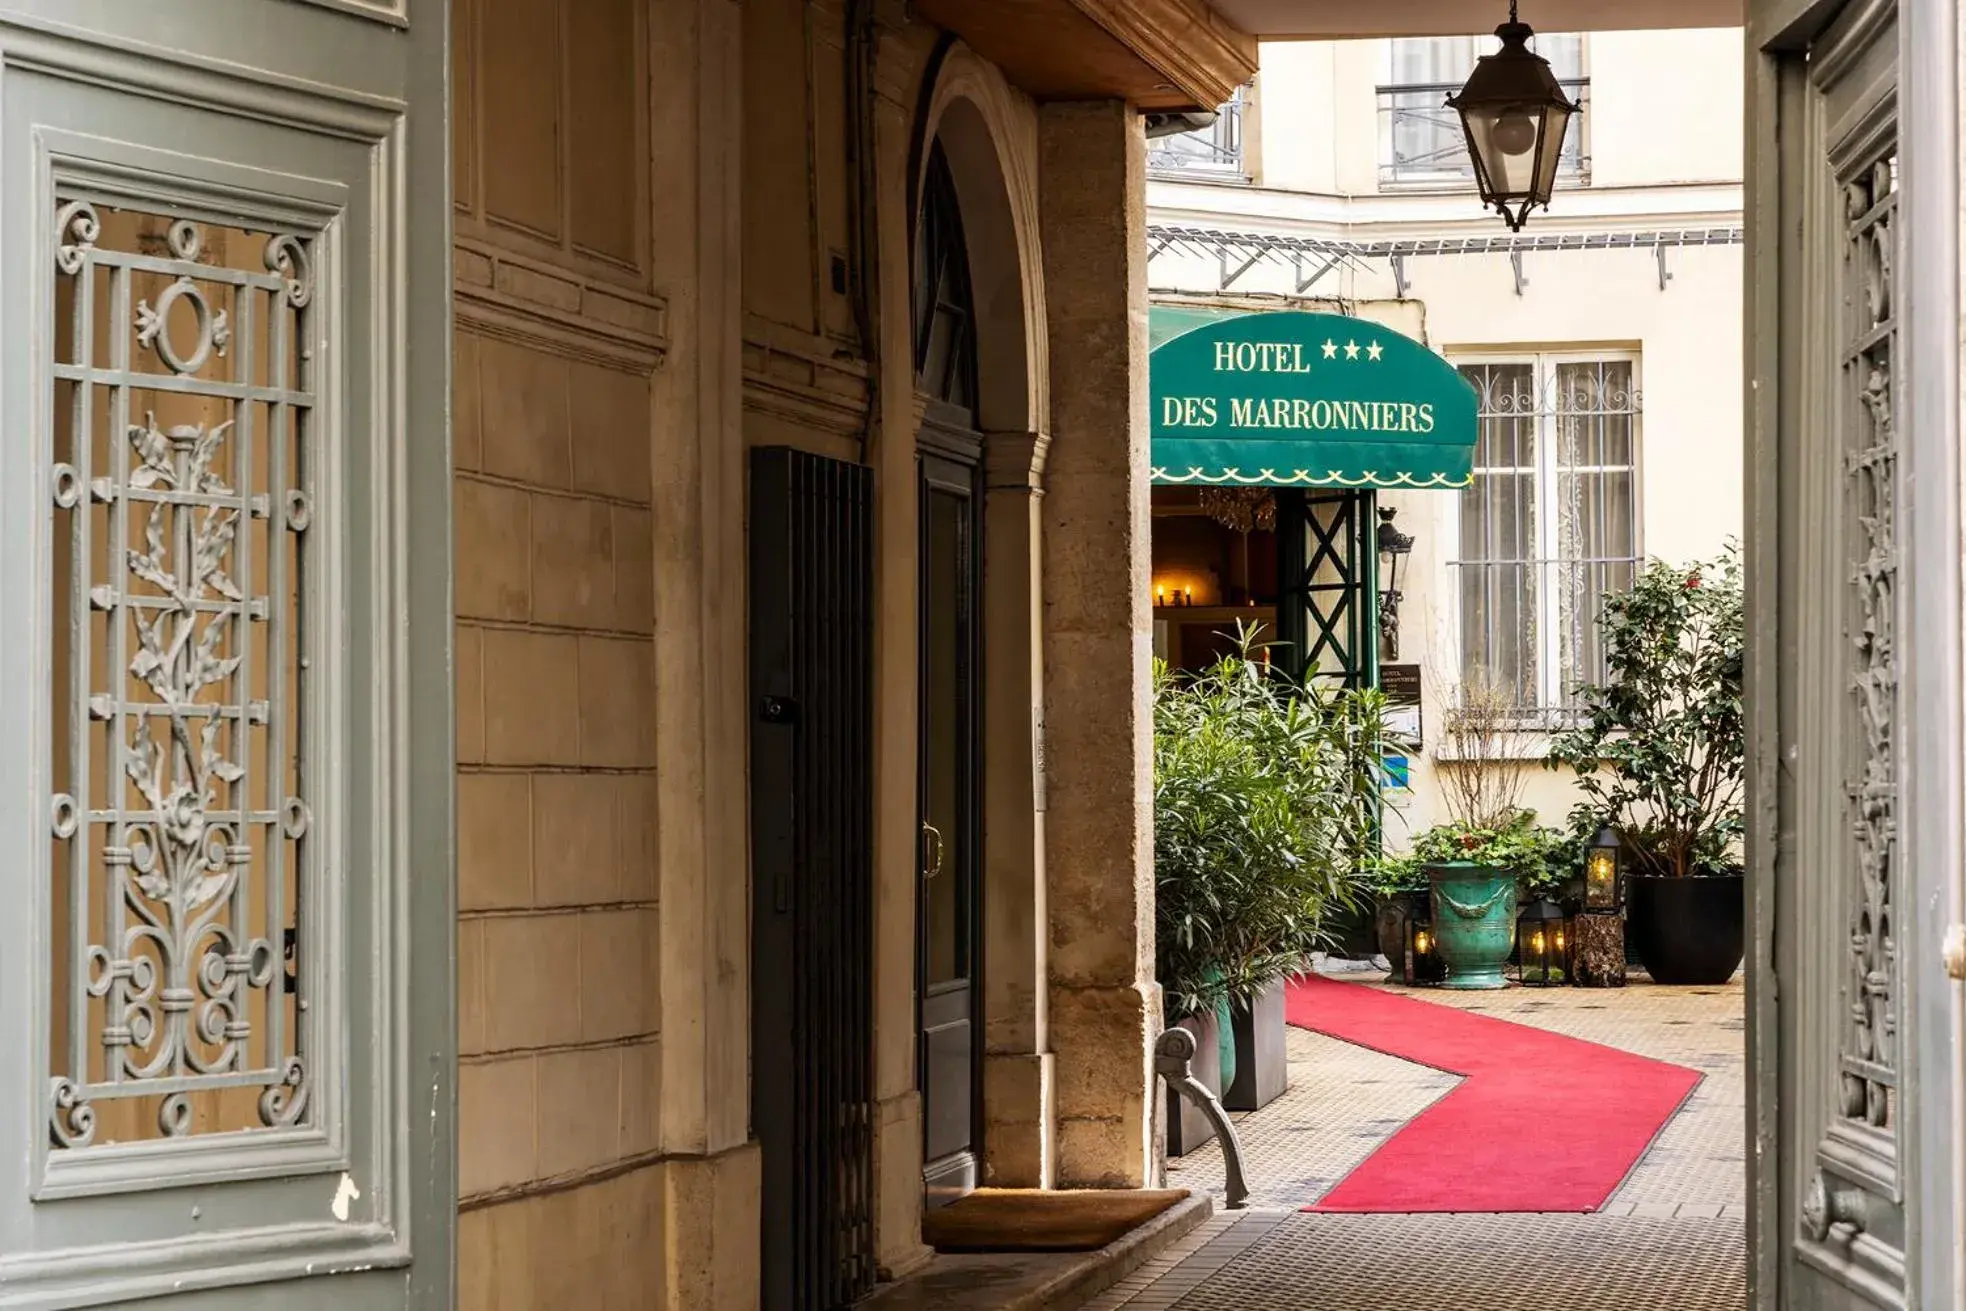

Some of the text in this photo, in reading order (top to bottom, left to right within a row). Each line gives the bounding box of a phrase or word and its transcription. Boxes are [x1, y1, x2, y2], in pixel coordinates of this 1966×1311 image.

[1214, 341, 1311, 373] HOTEL
[1162, 397, 1434, 433] DES MARRONNIERS
